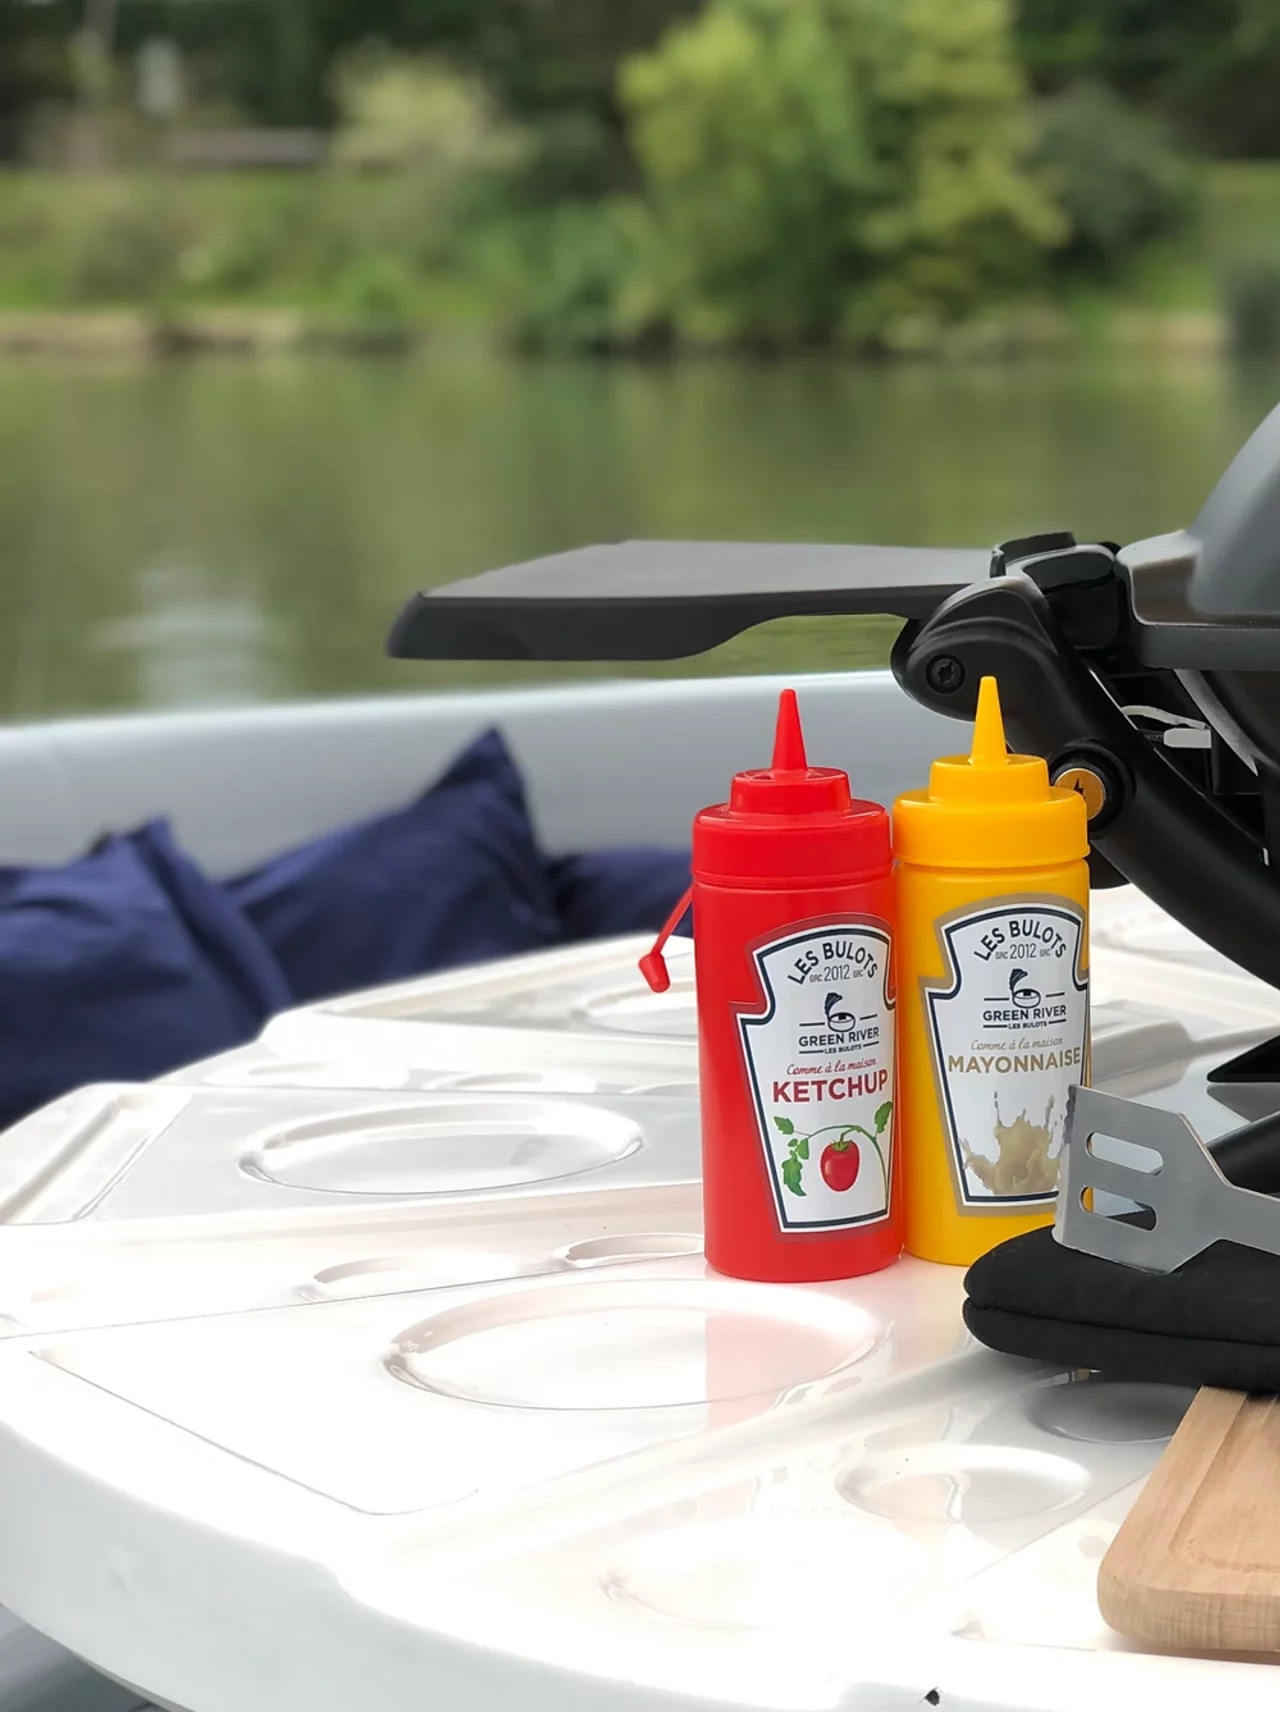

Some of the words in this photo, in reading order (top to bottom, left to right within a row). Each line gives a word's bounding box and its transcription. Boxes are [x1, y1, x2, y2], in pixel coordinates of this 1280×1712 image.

[974, 927, 1005, 961] LES
[1009, 919, 1066, 958] BULOTS
[995, 951, 1008, 960] GRC
[1009, 943, 1037, 959] 2012
[787, 950, 819, 985] LES
[822, 940, 878, 978] BULOTS
[824, 964, 850, 981] 2012
[983, 1009, 1029, 1022] GREEN
[1033, 1004, 1067, 1019] RIVER
[1008, 1022, 1021, 1030] LES
[1023, 1021, 1048, 1029] BULOTS
[799, 1033, 844, 1047] GREEN
[848, 1026, 880, 1043] RIVER
[971, 1039, 1006, 1051] Comme
[1008, 1038, 1017, 1050] à
[1018, 1037, 1029, 1050] la
[1031, 1036, 1063, 1048] maison
[824, 1047, 837, 1055] LES
[839, 1044, 862, 1053] BULOTS
[787, 1063, 824, 1075] Comme
[824, 1062, 832, 1073] à
[834, 1059, 847, 1072] la
[847, 1057, 877, 1069] maison
[948, 1047, 1081, 1073] MAYONNAISE
[772, 1068, 888, 1103] KETCHUP
